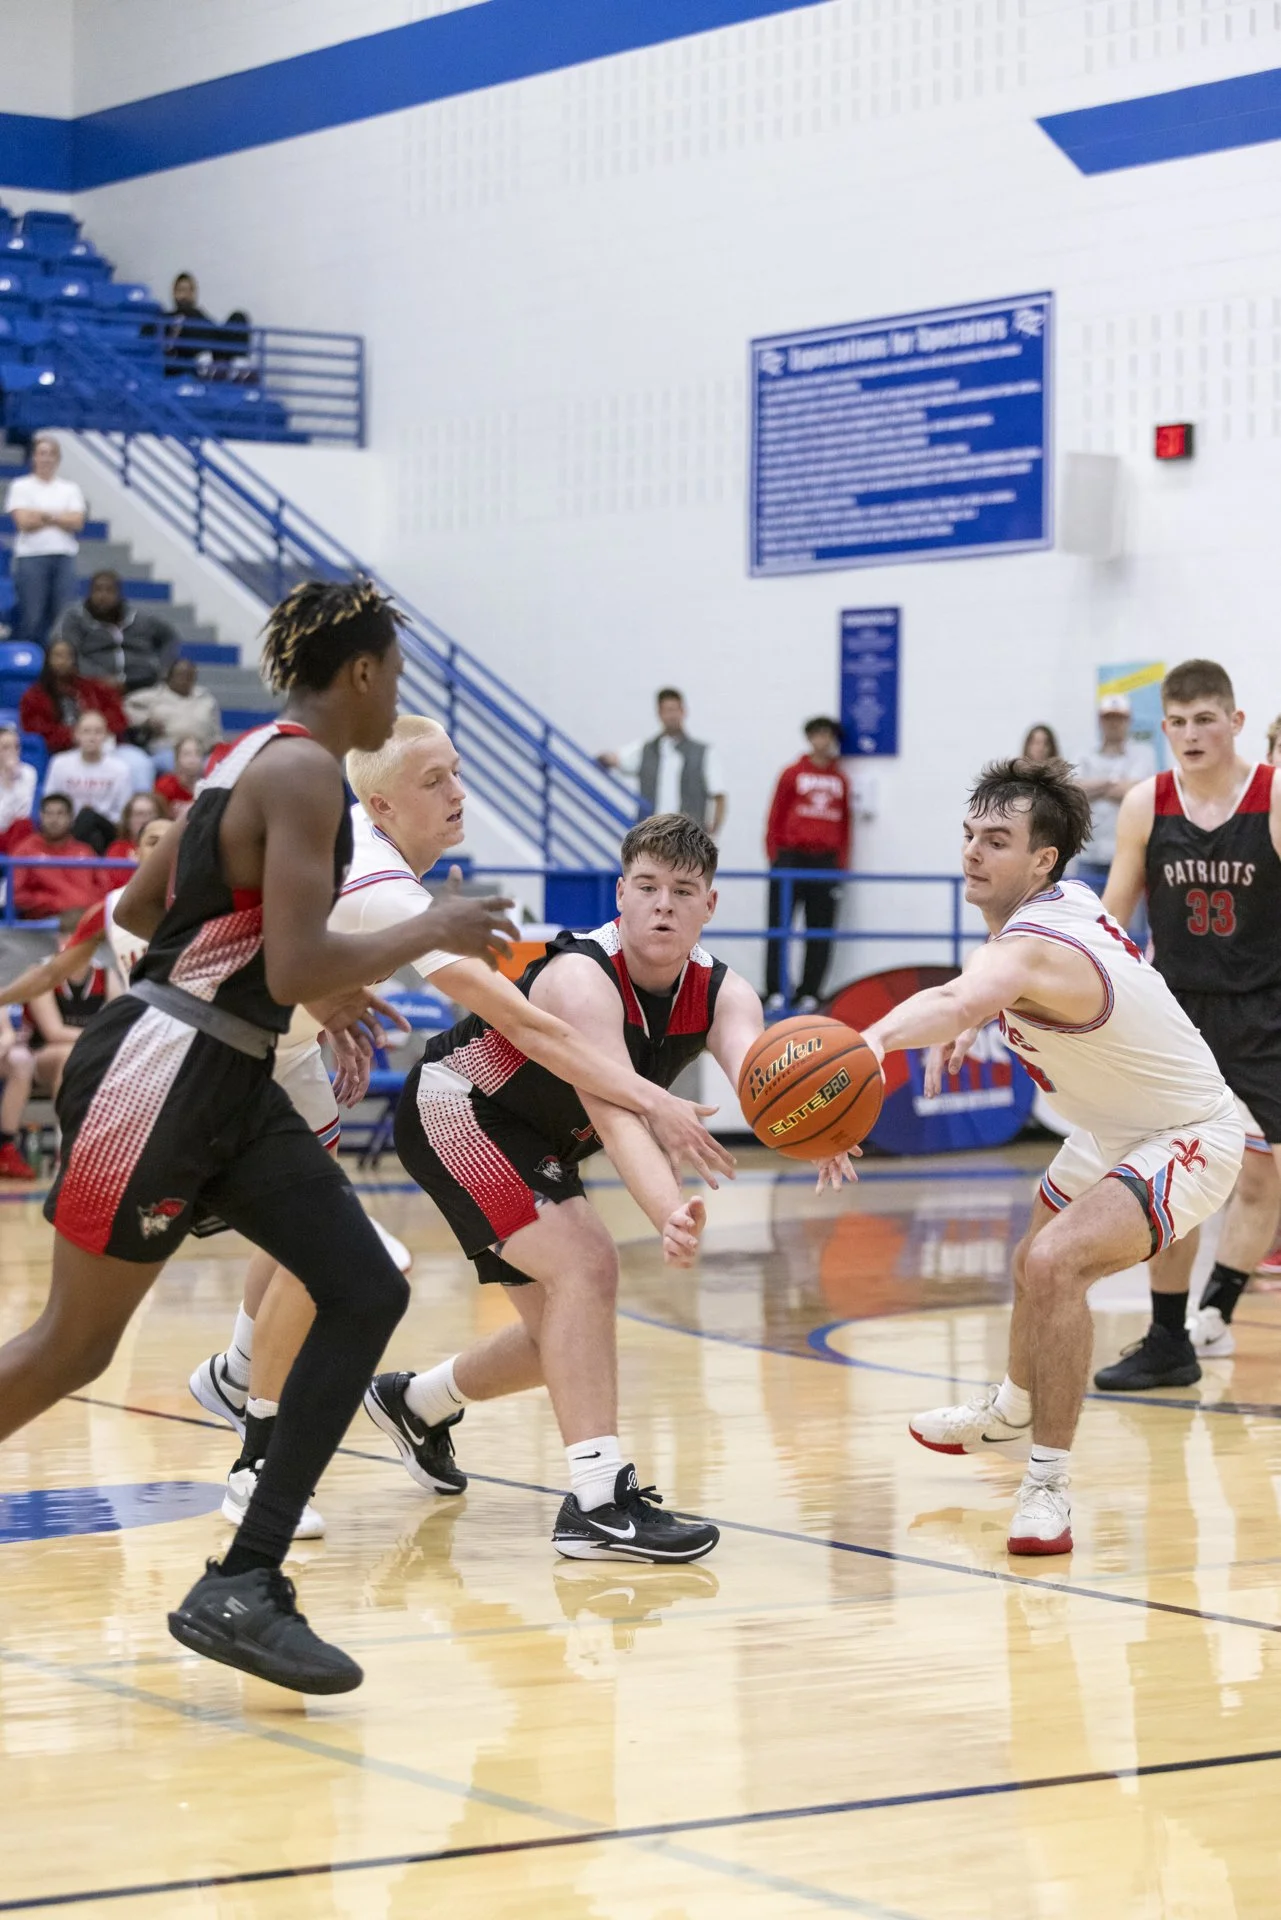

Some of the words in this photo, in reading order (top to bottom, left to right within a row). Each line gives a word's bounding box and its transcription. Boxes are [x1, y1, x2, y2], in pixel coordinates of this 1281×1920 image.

[1164, 859, 1256, 887] PATRIOTS
[1186, 888, 1236, 936] 33
[749, 1037, 823, 1103] Baden
[768, 1093, 827, 1137] ELITE
[821, 1069, 851, 1103] PRO
